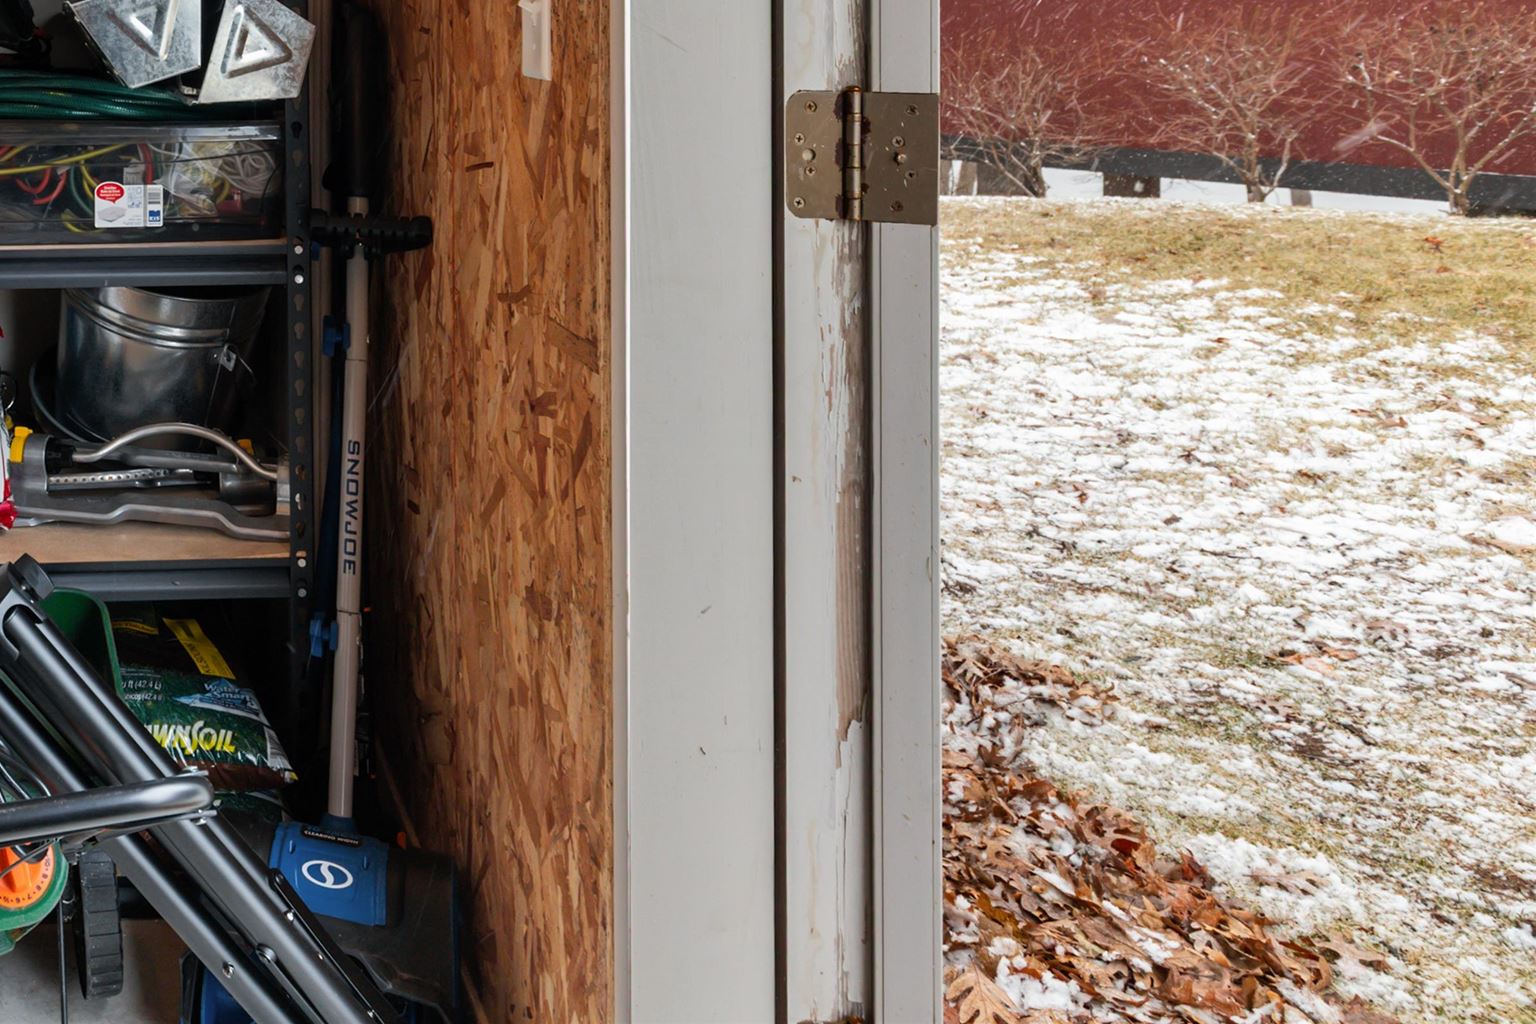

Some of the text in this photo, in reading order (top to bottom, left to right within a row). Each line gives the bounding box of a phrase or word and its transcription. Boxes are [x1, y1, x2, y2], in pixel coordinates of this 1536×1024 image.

[342, 439, 361, 576] SNOWJOE
[204, 683, 240, 693] Water
[144, 720, 236, 755] WNSOIL
